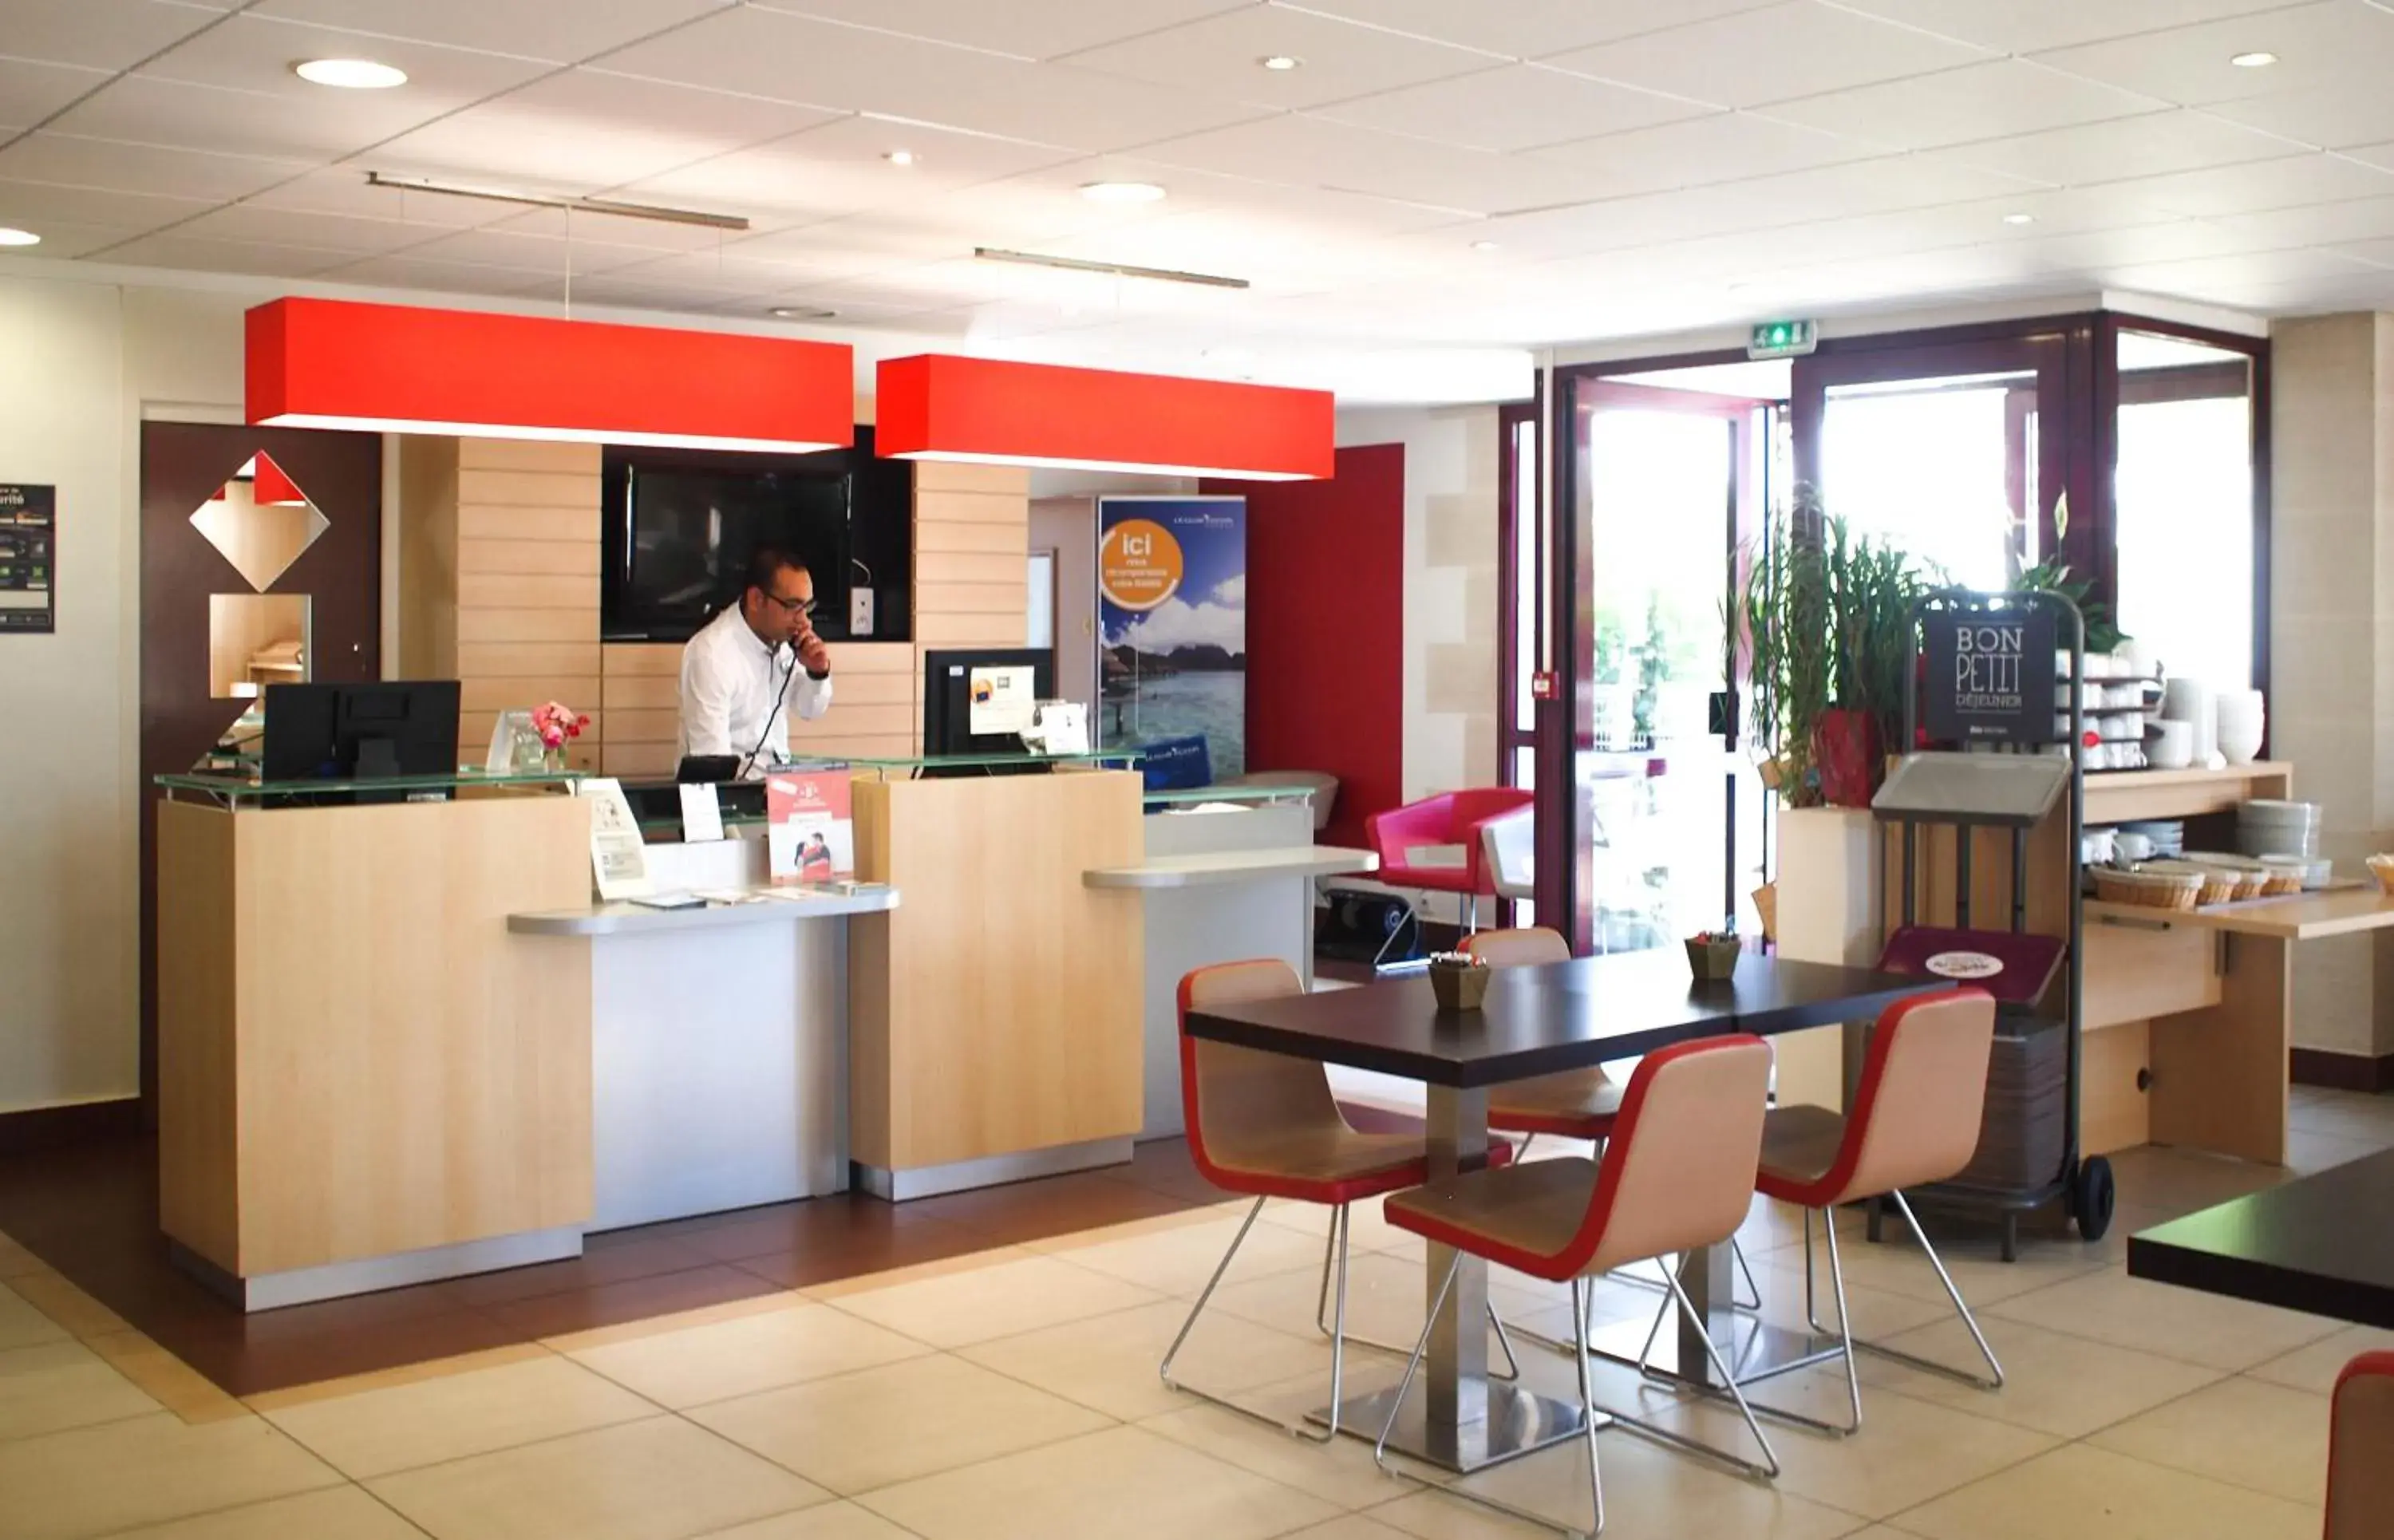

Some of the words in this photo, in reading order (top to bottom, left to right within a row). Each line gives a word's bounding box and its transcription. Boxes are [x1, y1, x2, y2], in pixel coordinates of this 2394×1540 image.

[1123, 532, 1151, 556] ici
[1957, 627, 2024, 652] BON
[1956, 653, 2023, 693] PETIT
